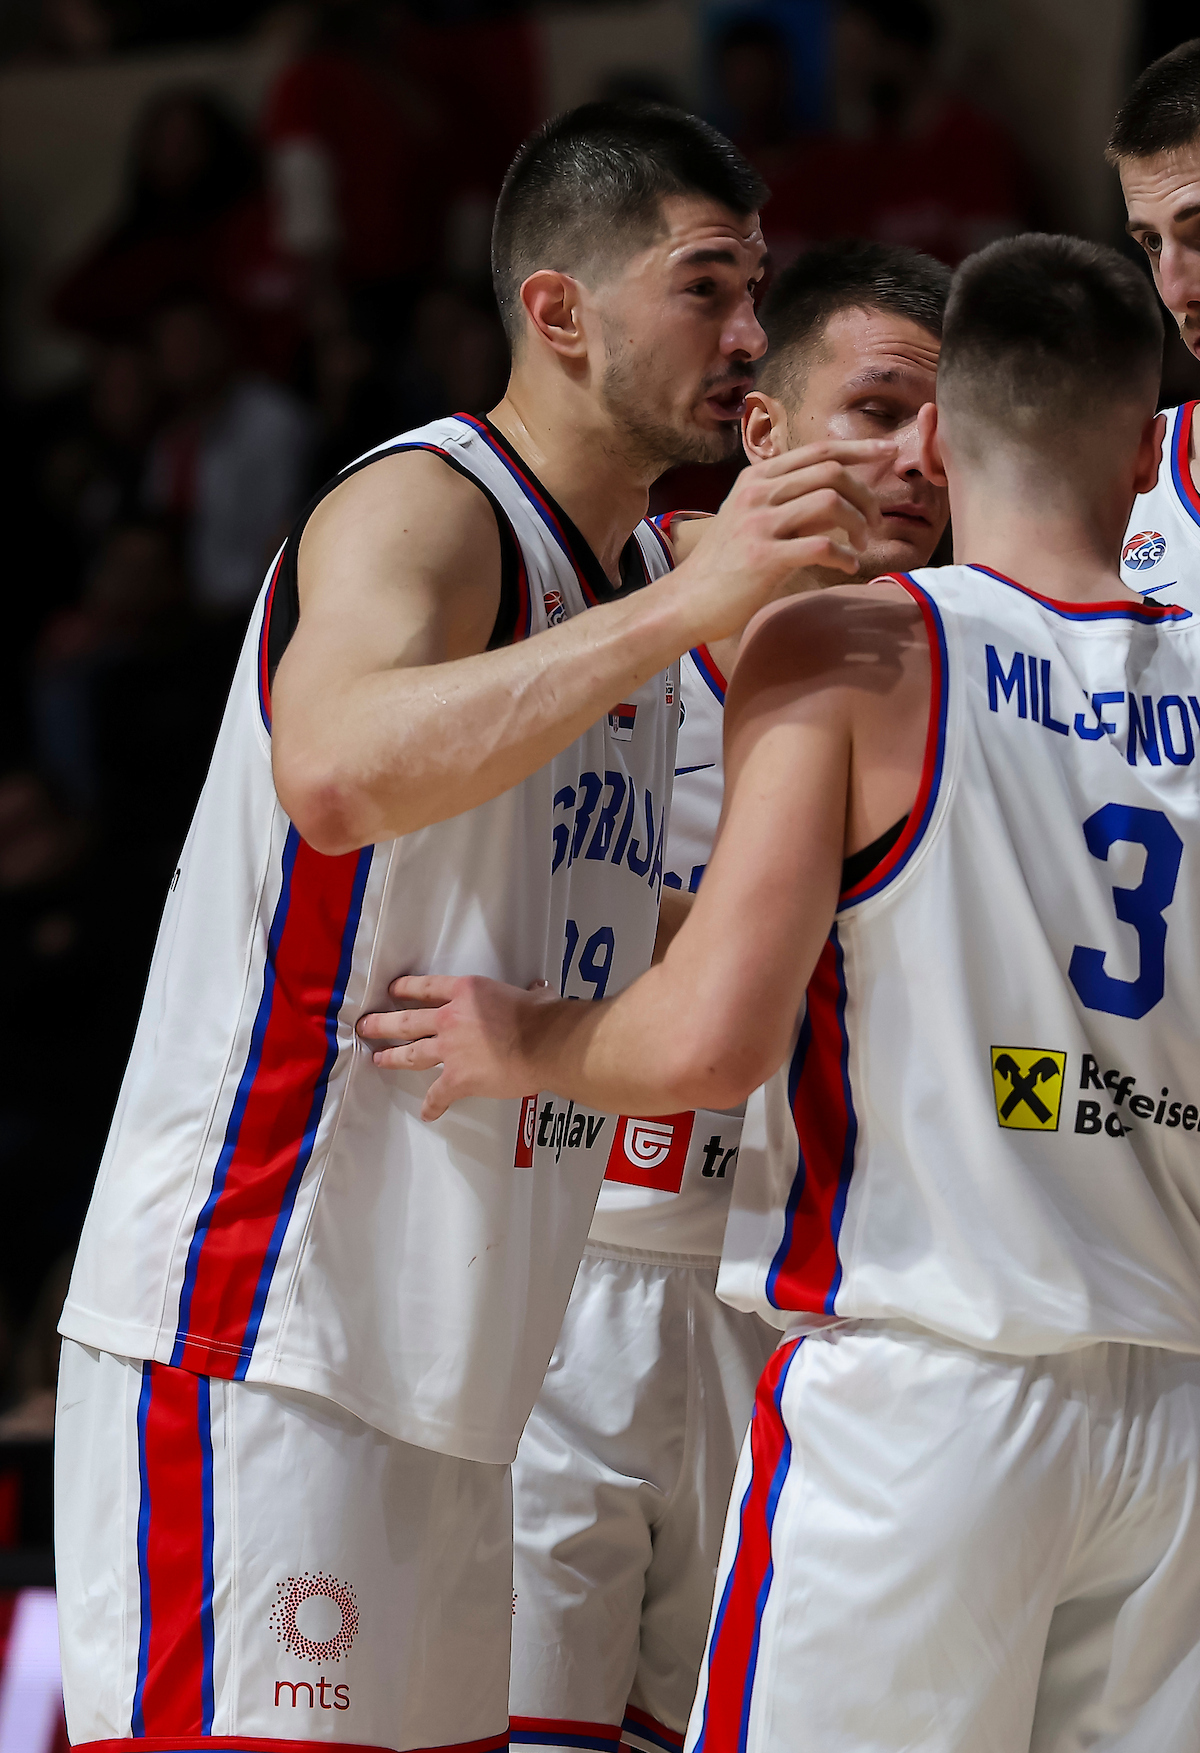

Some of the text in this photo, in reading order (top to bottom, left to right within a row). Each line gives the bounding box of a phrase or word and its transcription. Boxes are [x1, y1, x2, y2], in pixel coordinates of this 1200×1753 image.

[1126, 547, 1161, 561] KCC
[1068, 802, 1184, 1021] 3
[274, 1676, 351, 1711] mts
